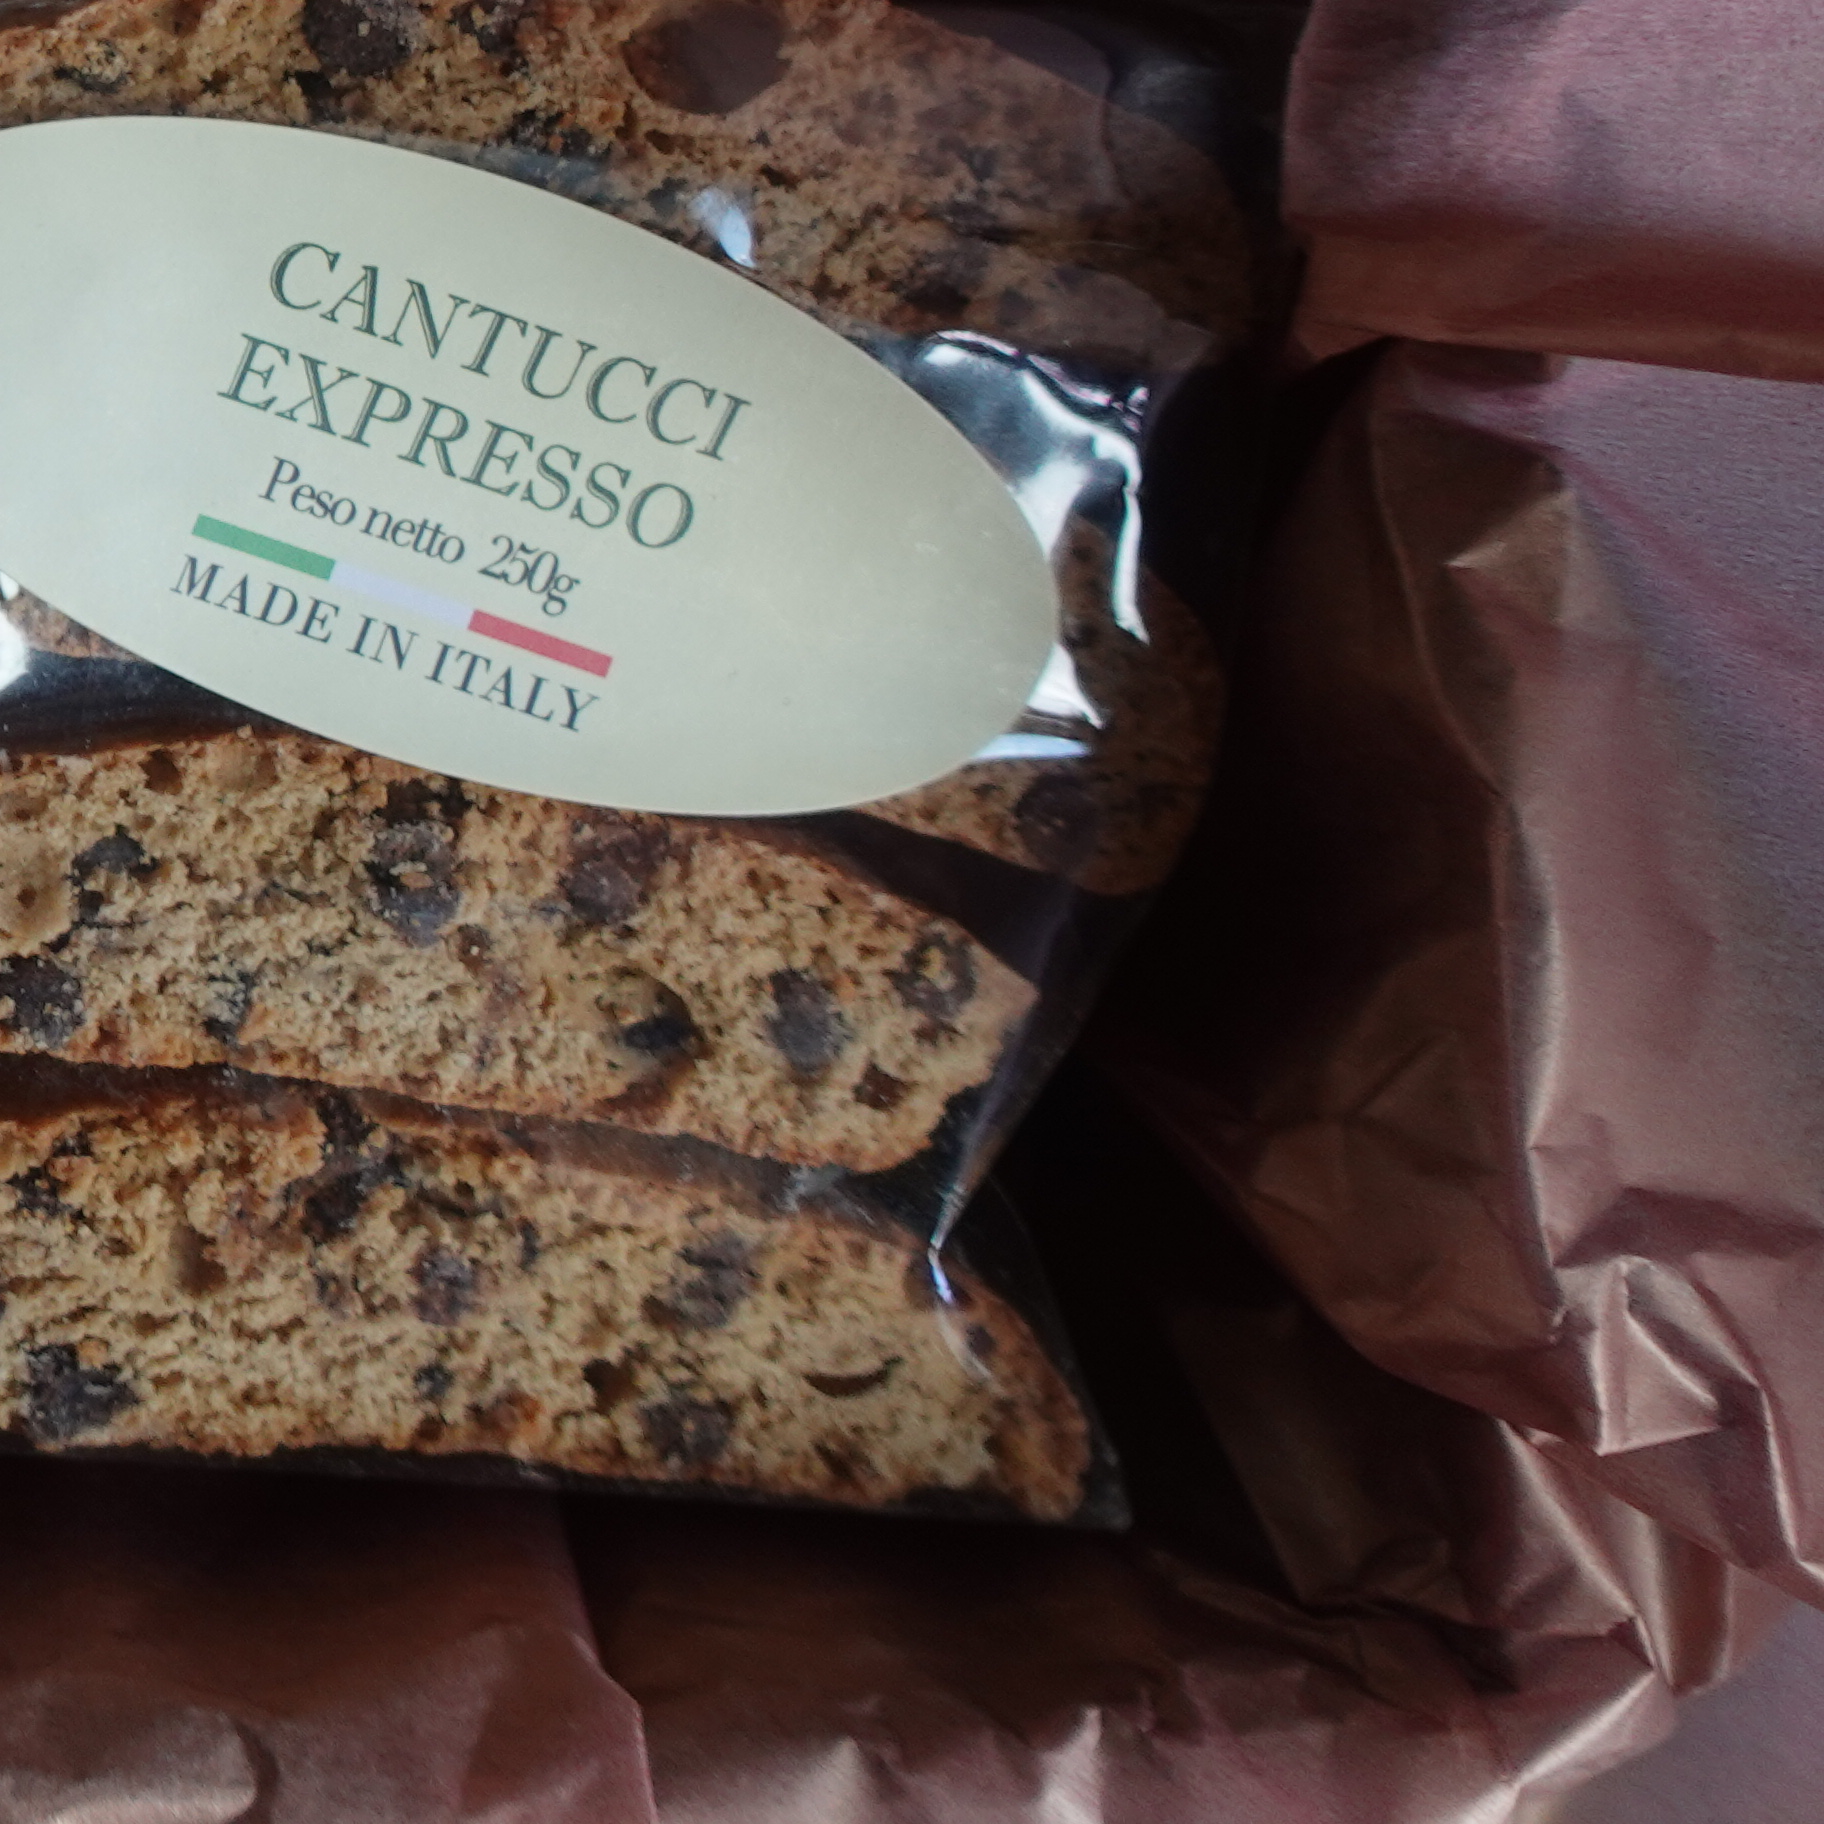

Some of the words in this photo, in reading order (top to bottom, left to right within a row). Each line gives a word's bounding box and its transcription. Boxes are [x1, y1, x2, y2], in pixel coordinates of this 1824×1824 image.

[216, 331, 695, 550] EXPRESSO
[267, 240, 752, 462] CANTUCCI
[257, 456, 358, 528] Peso
[359, 508, 468, 566] netto
[477, 533, 582, 617] 250g
[169, 554, 342, 645] MADE
[345, 613, 420, 673] IN
[423, 640, 601, 734] ITALY
